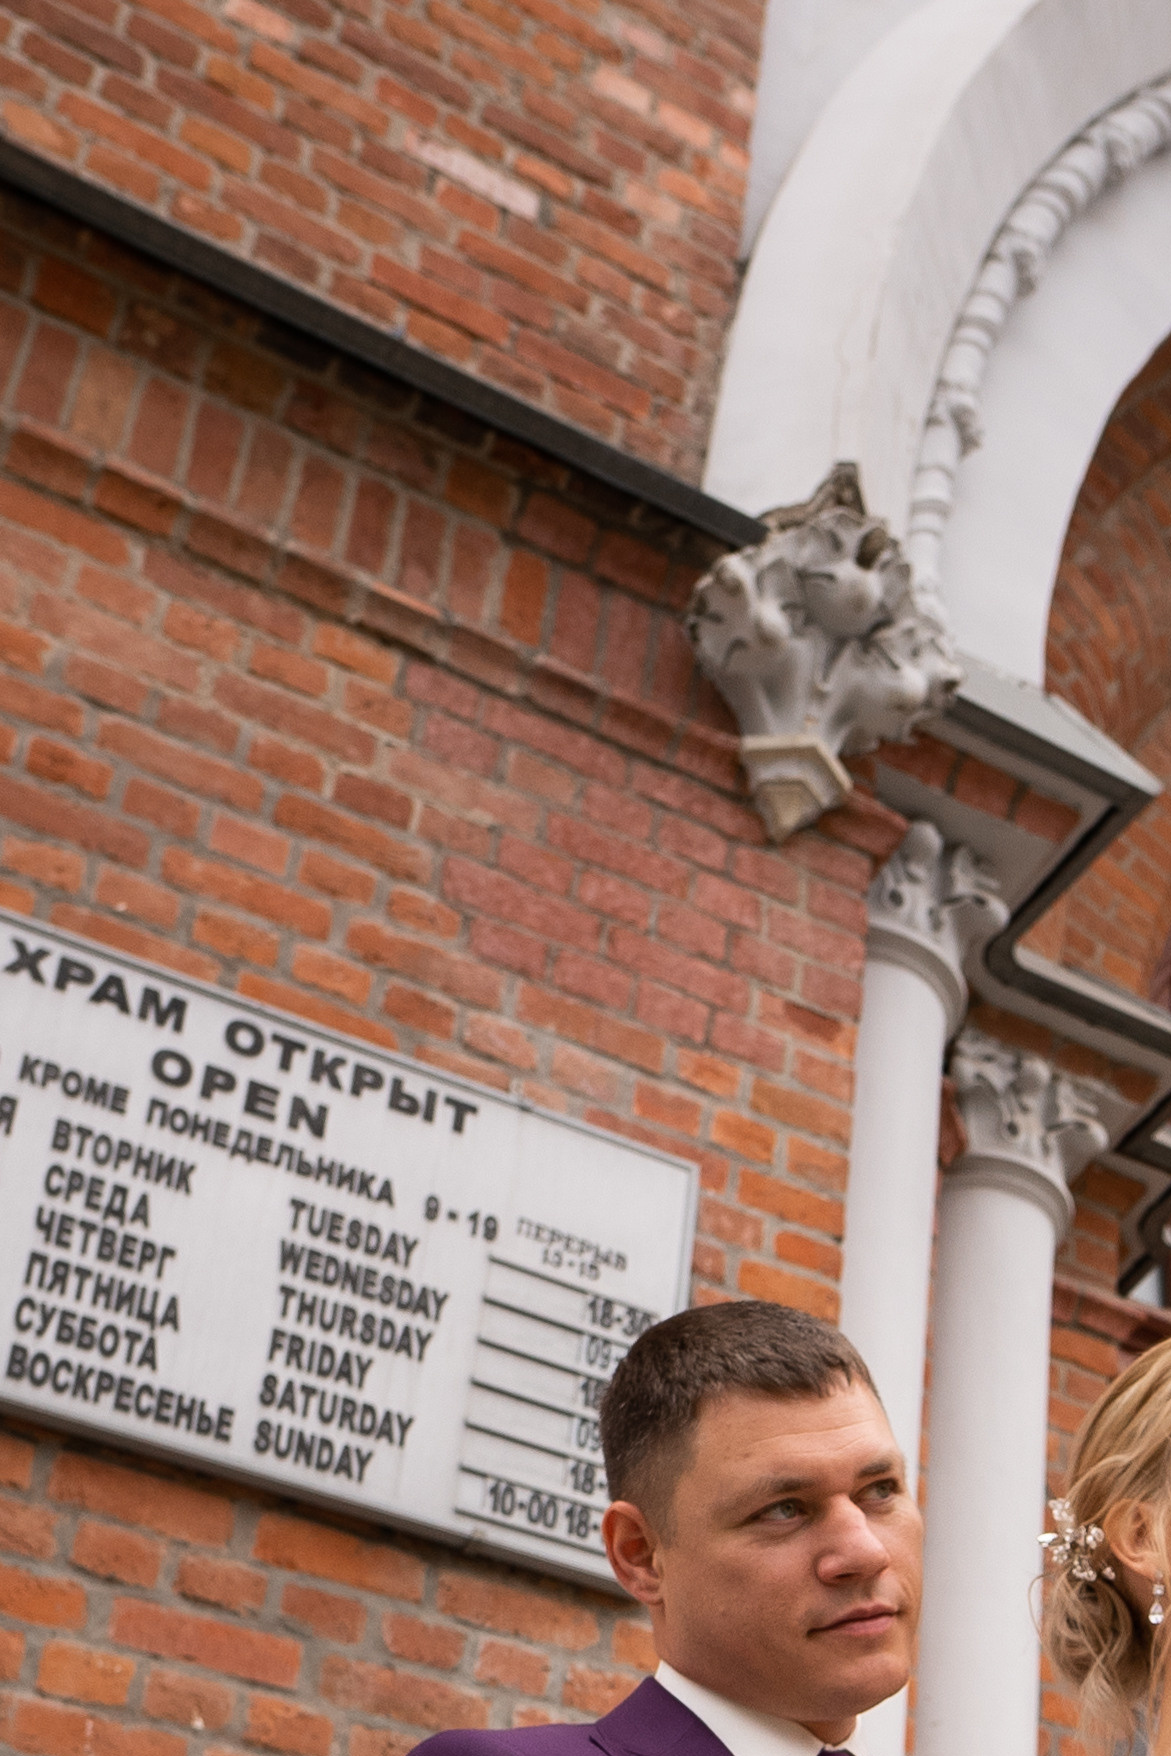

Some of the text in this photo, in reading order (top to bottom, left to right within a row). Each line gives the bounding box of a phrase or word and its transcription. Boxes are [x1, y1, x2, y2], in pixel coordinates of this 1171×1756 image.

[4, 936, 479, 1135] ХРАМ ОТКРЫТ
[151, 1048, 328, 1139] OPEN
[19, 1053, 130, 1116] КРОМЕ
[146, 1097, 395, 1208] ПОНЕДЕЛЬНИКА
[468, 1211, 498, 1242] 19
[52, 1118, 196, 1195] ВТОРНИК
[44, 1164, 151, 1229] СРЕДА
[290, 1198, 418, 1268] TUESDAY
[35, 1204, 177, 1280] ЧЕТВЕРГ
[516, 1216, 628, 1272] ПЕРЕРЫВ
[24, 1251, 180, 1332] ПЯТНИЦА
[279, 1239, 448, 1322] WEDNESDAY
[14, 1297, 157, 1371] СУББОТА
[267, 1328, 374, 1389] FRIDAY
[279, 1285, 433, 1362] THURSDAY
[6, 1344, 235, 1442] ВОСКРЕСЕНЬЕ
[259, 1374, 414, 1448] SATURDAY
[254, 1420, 373, 1482] SUNDAY
